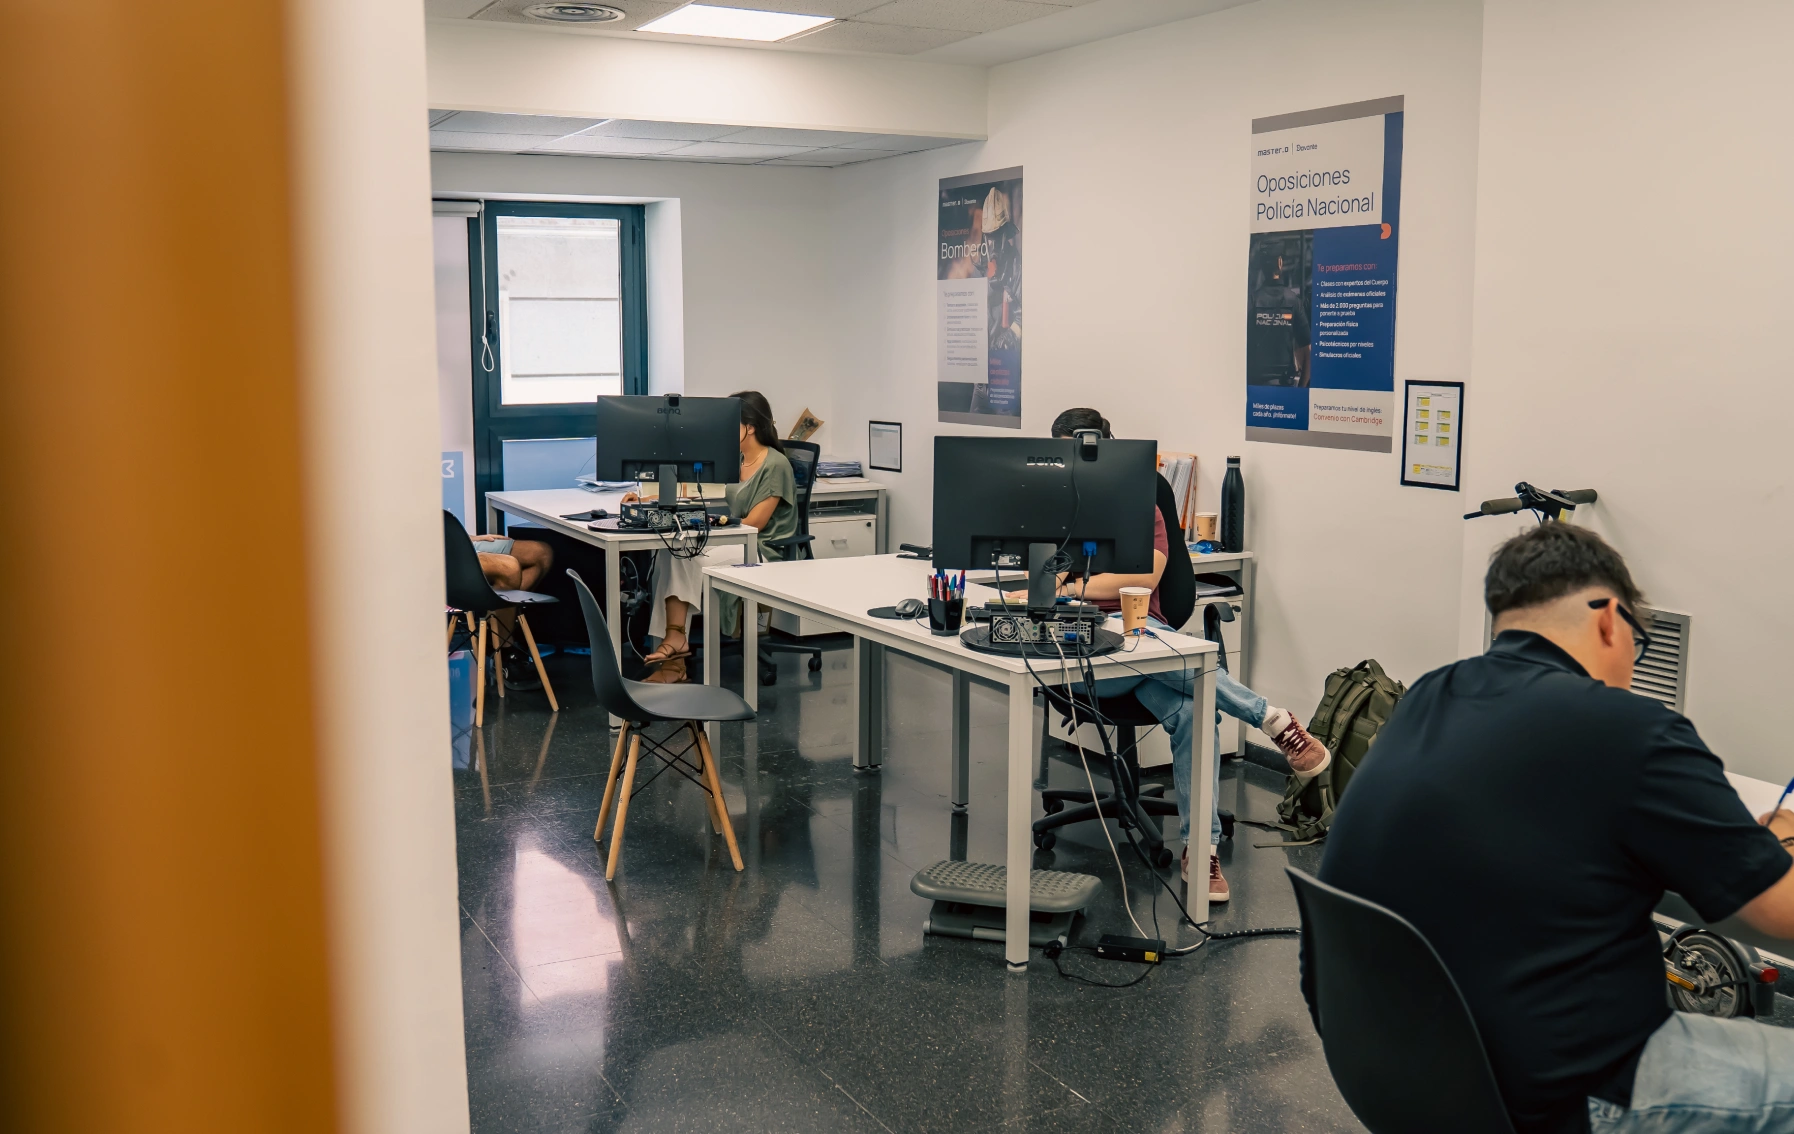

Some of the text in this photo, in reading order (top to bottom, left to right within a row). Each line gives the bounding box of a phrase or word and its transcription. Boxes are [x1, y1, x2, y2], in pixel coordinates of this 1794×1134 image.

[1257, 169, 1350, 197] Oposiciones
[1257, 192, 1374, 220] Policía Nacional
[941, 242, 987, 259] Bombero
[1326, 264, 1362, 273] preparamos
[1314, 413, 1339, 422] Convenio
[1351, 414, 1383, 426] Cambridge
[1027, 456, 1065, 468] BenQ
